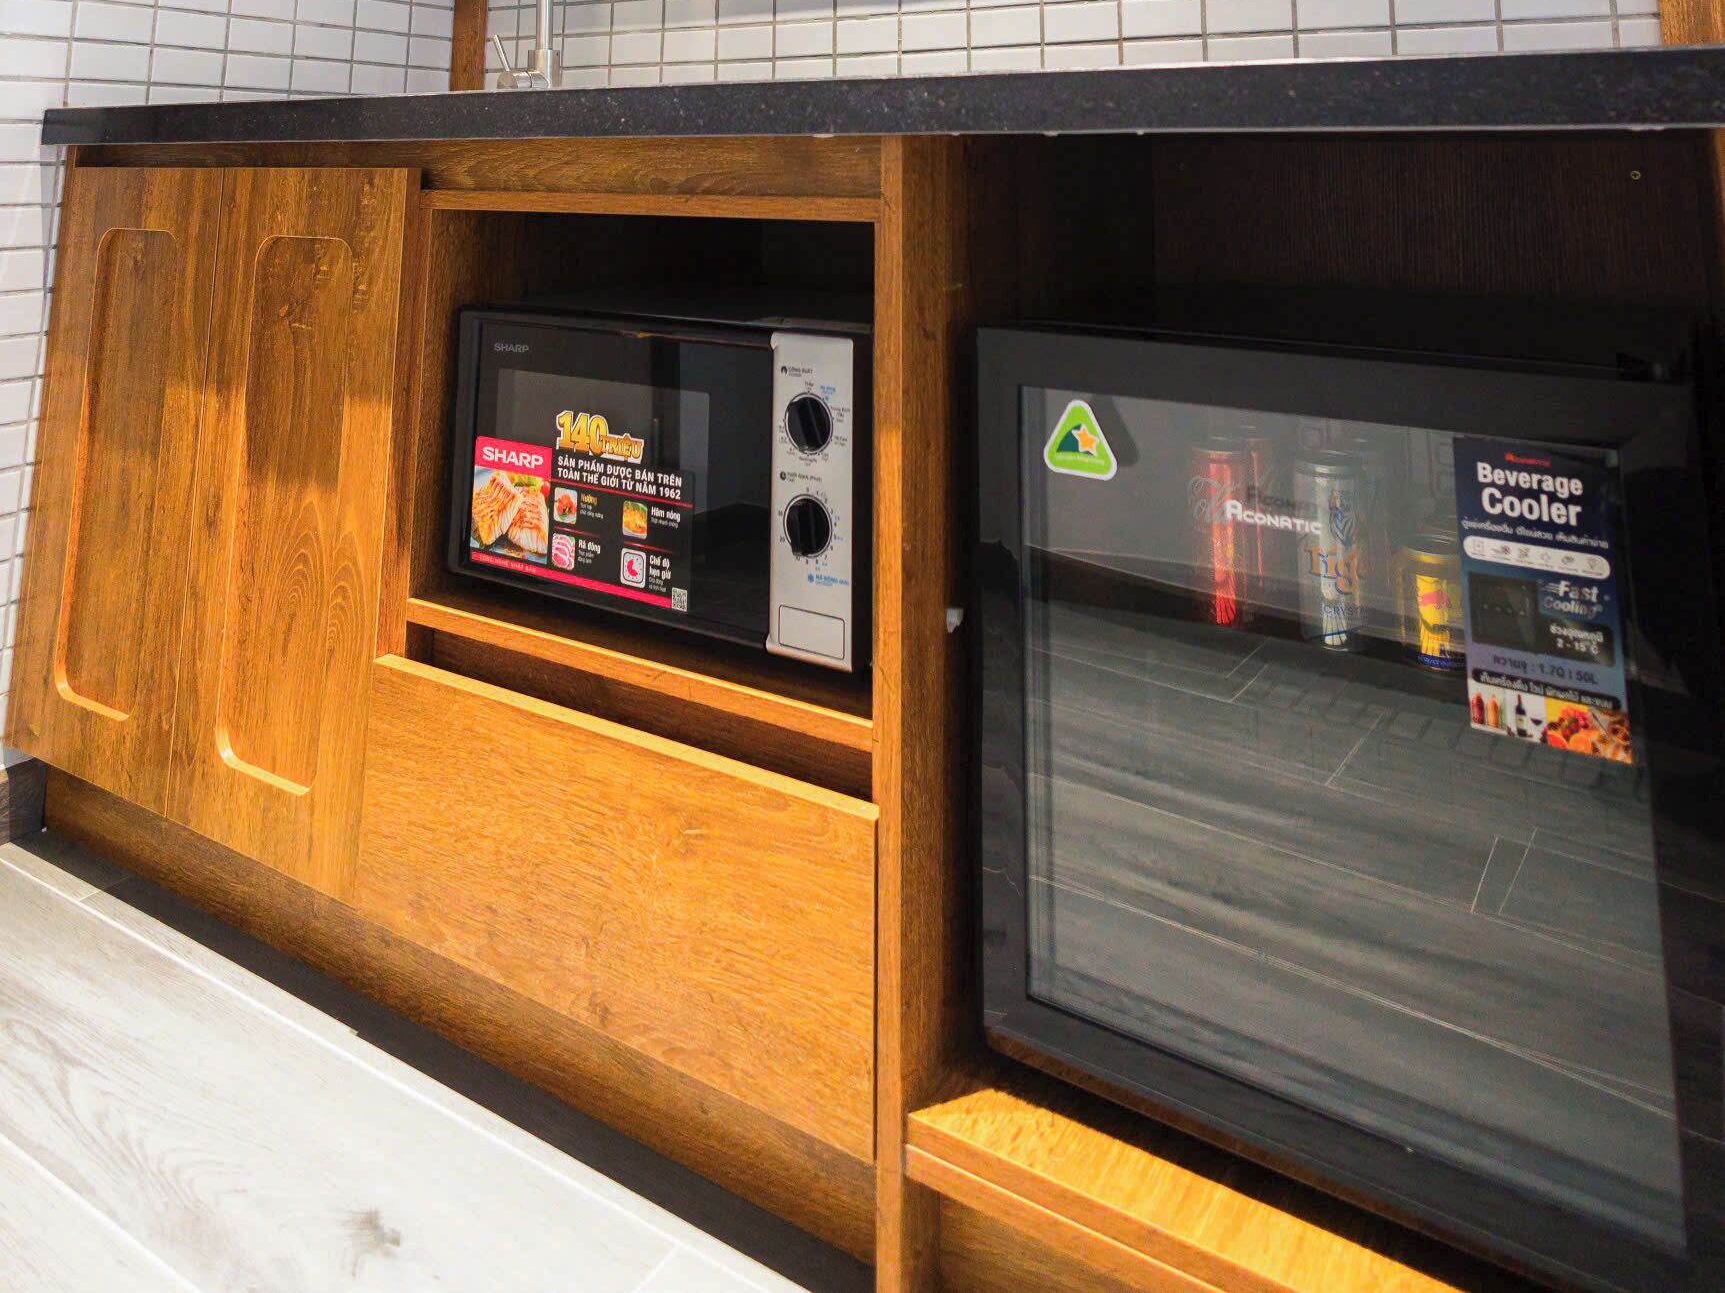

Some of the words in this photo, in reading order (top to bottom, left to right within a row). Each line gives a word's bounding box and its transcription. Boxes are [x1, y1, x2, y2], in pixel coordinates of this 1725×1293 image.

[494, 342, 529, 353] SHARP
[556, 410, 609, 457] 140
[482, 446, 544, 469] SHARP
[557, 455, 575, 467] SẢN
[606, 464, 633, 480] ĐƯỢC
[635, 468, 656, 483] BÁN
[657, 471, 683, 487] TRÊN
[557, 467, 580, 481] TOÀN
[582, 470, 599, 485] THẾ
[600, 474, 620, 489] GIỚI
[621, 478, 635, 492] TỪ
[635, 480, 657, 496] NĂM
[659, 486, 681, 501] 1962
[1476, 461, 1584, 499] Beverage
[650, 506, 665, 518] Hâm
[666, 510, 681, 522] nóng
[1481, 486, 1583, 526] Cooler
[1557, 579, 1600, 602] Fast
[1544, 596, 1599, 619] Cooling
